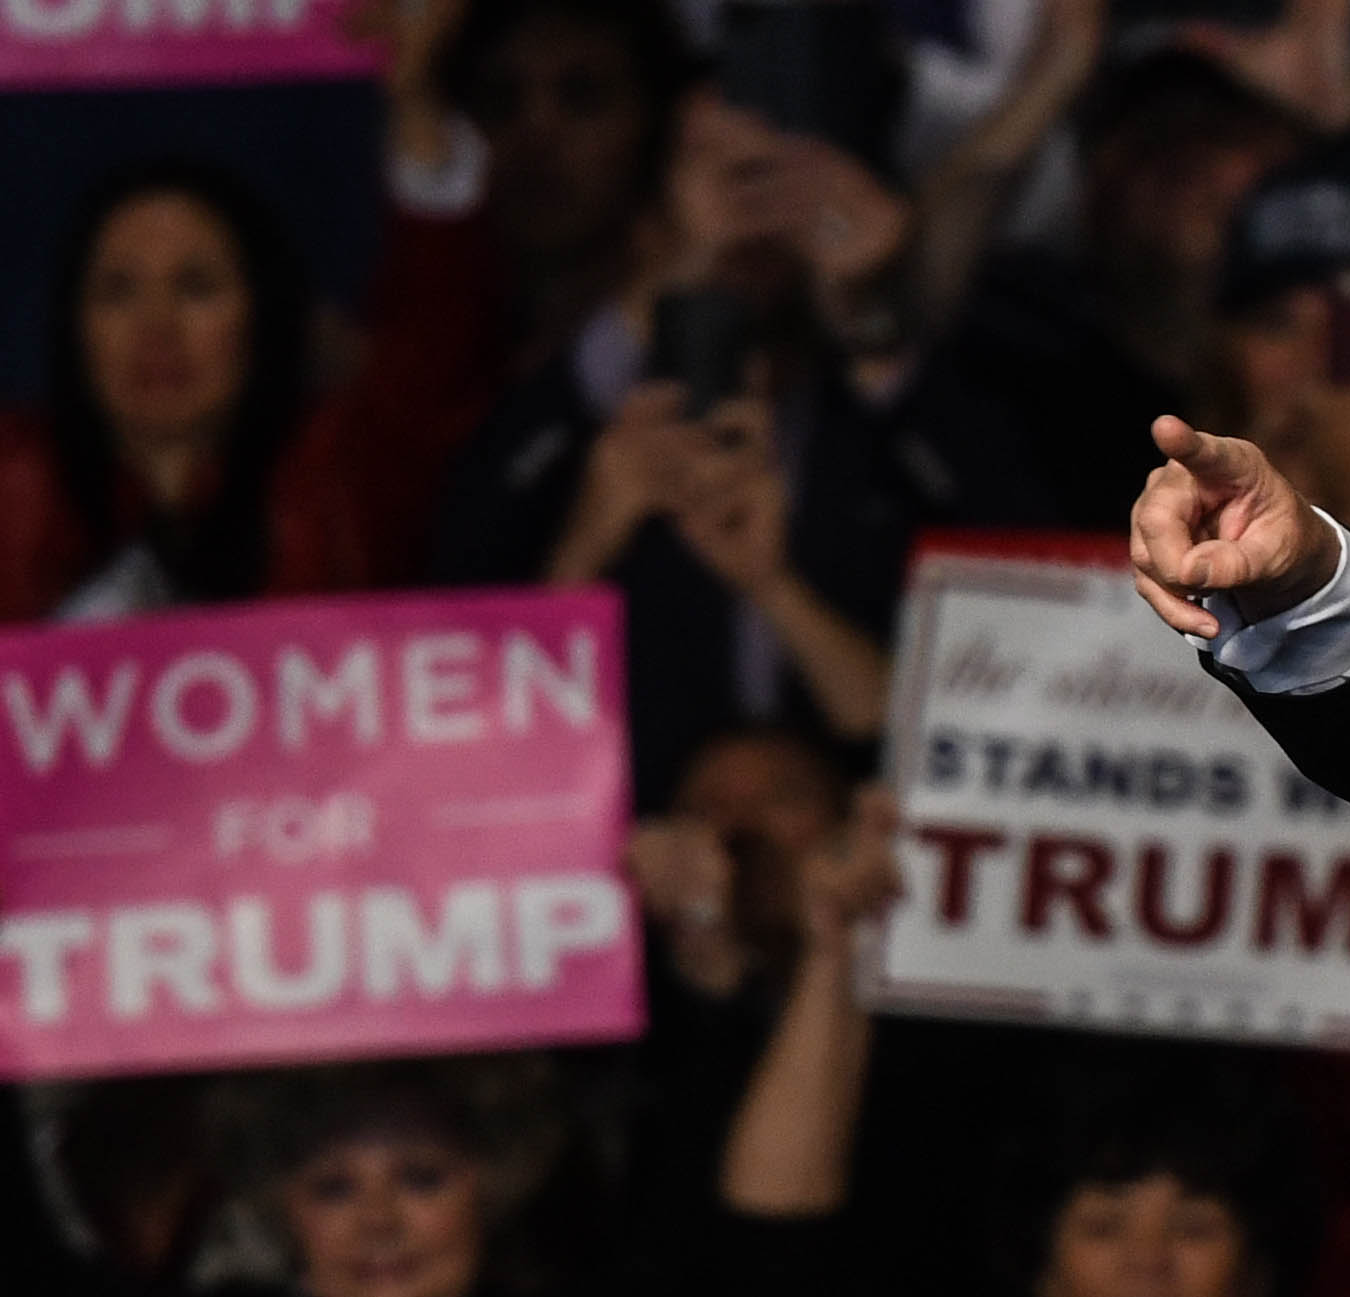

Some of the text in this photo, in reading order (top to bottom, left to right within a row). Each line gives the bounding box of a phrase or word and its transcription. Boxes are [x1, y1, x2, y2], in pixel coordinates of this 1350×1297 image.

[4, 624, 598, 775] WOMEN
[212, 793, 375, 862] FOR
[926, 724, 1250, 816] STANDS
[0, 870, 626, 1026] TRUMP
